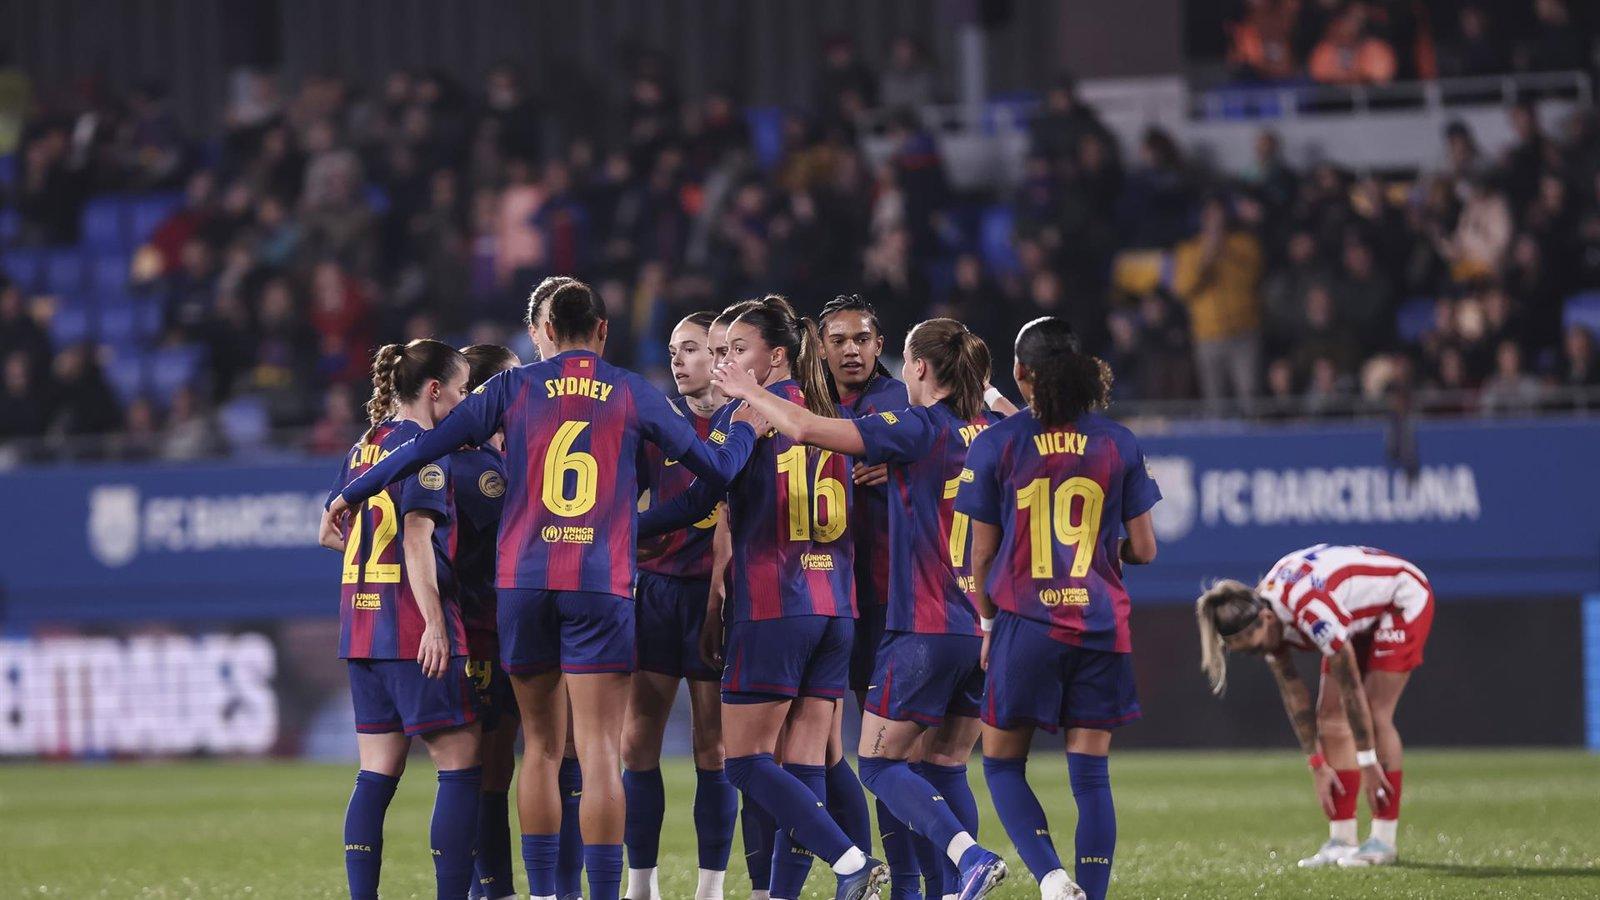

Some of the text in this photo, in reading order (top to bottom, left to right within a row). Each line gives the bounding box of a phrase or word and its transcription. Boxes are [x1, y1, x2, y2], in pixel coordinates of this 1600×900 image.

[545, 376, 614, 402] SYDNEY
[541, 420, 599, 518] 6
[1033, 431, 1088, 457] VICKY
[777, 445, 848, 543] 16
[1201, 463, 1481, 526] FC BARCELONA
[563, 526, 594, 534] UNHCR
[1016, 476, 1105, 578] 19
